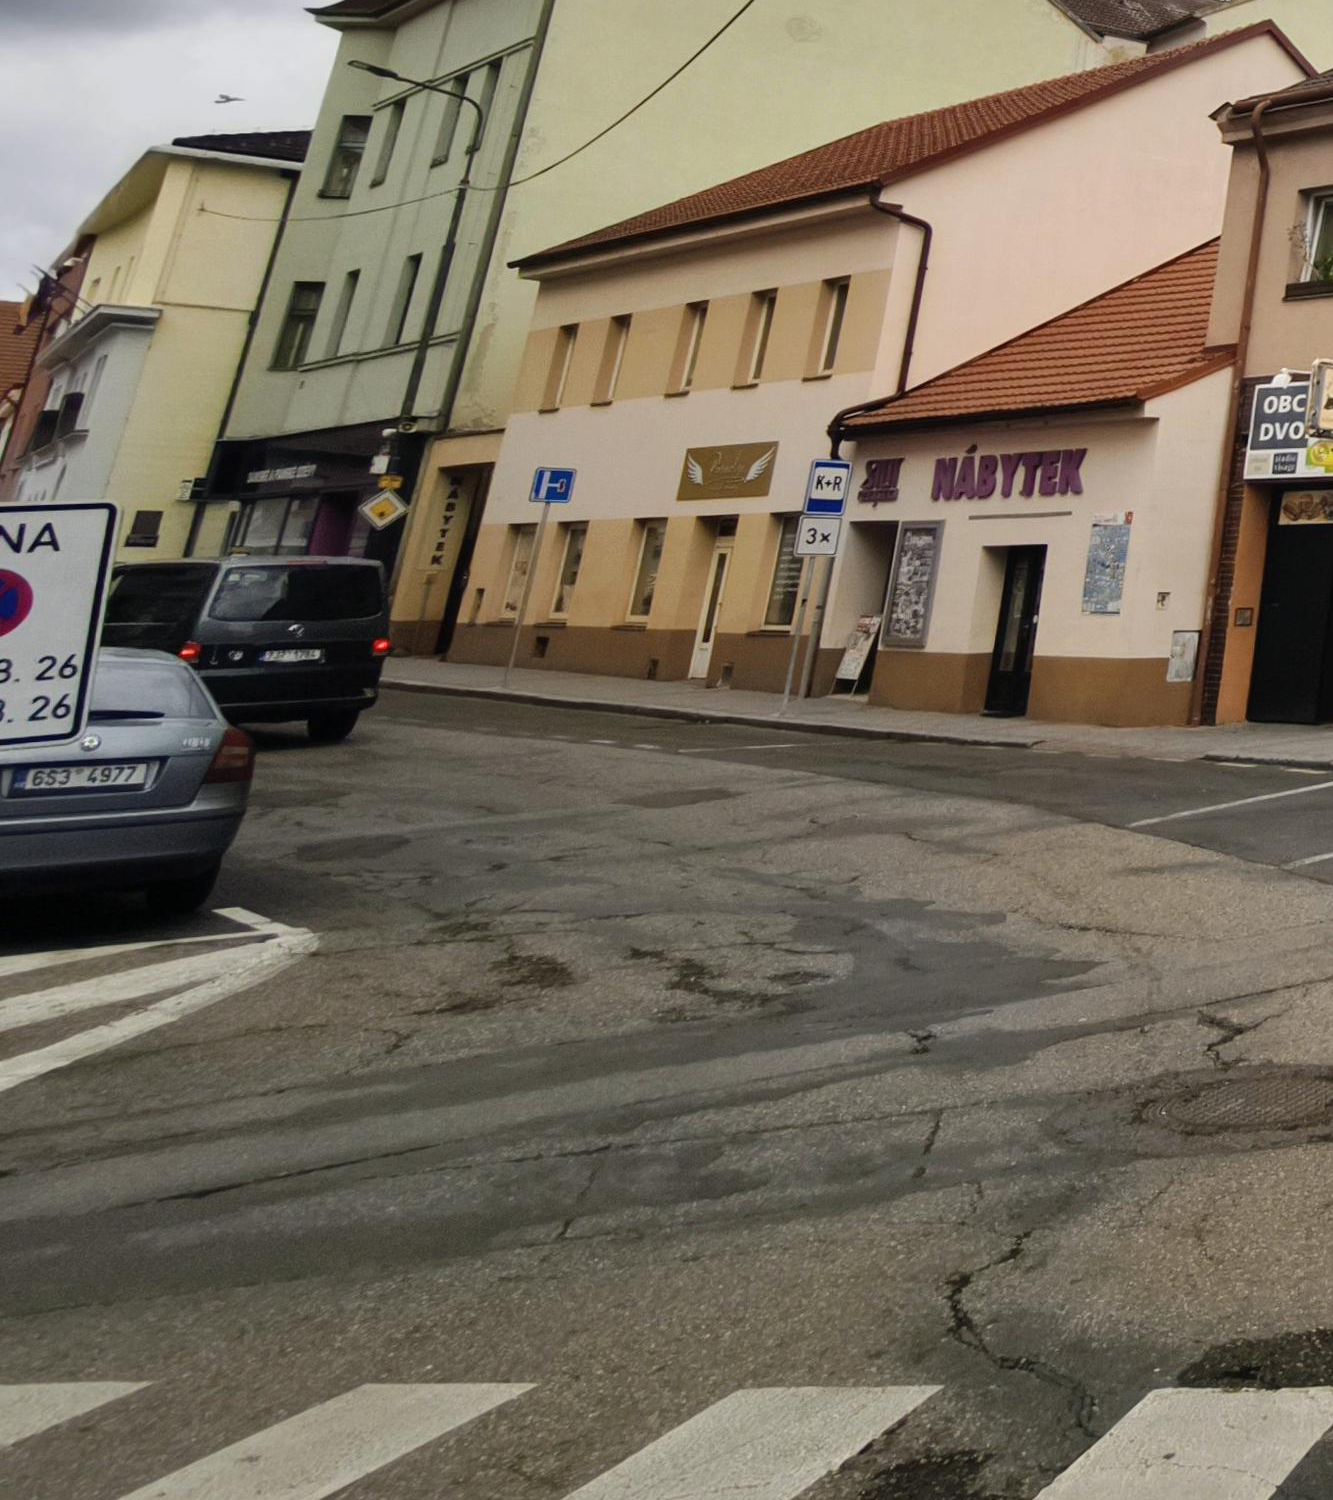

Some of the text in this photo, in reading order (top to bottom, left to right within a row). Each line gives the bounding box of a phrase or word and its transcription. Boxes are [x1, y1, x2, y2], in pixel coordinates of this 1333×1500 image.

[815, 475, 842, 492] K+R
[931, 445, 1088, 502] NÁBYTEK
[34, 653, 79, 682] 26
[27, 692, 72, 722] 26
[31, 765, 138, 787] 6S3 4977
